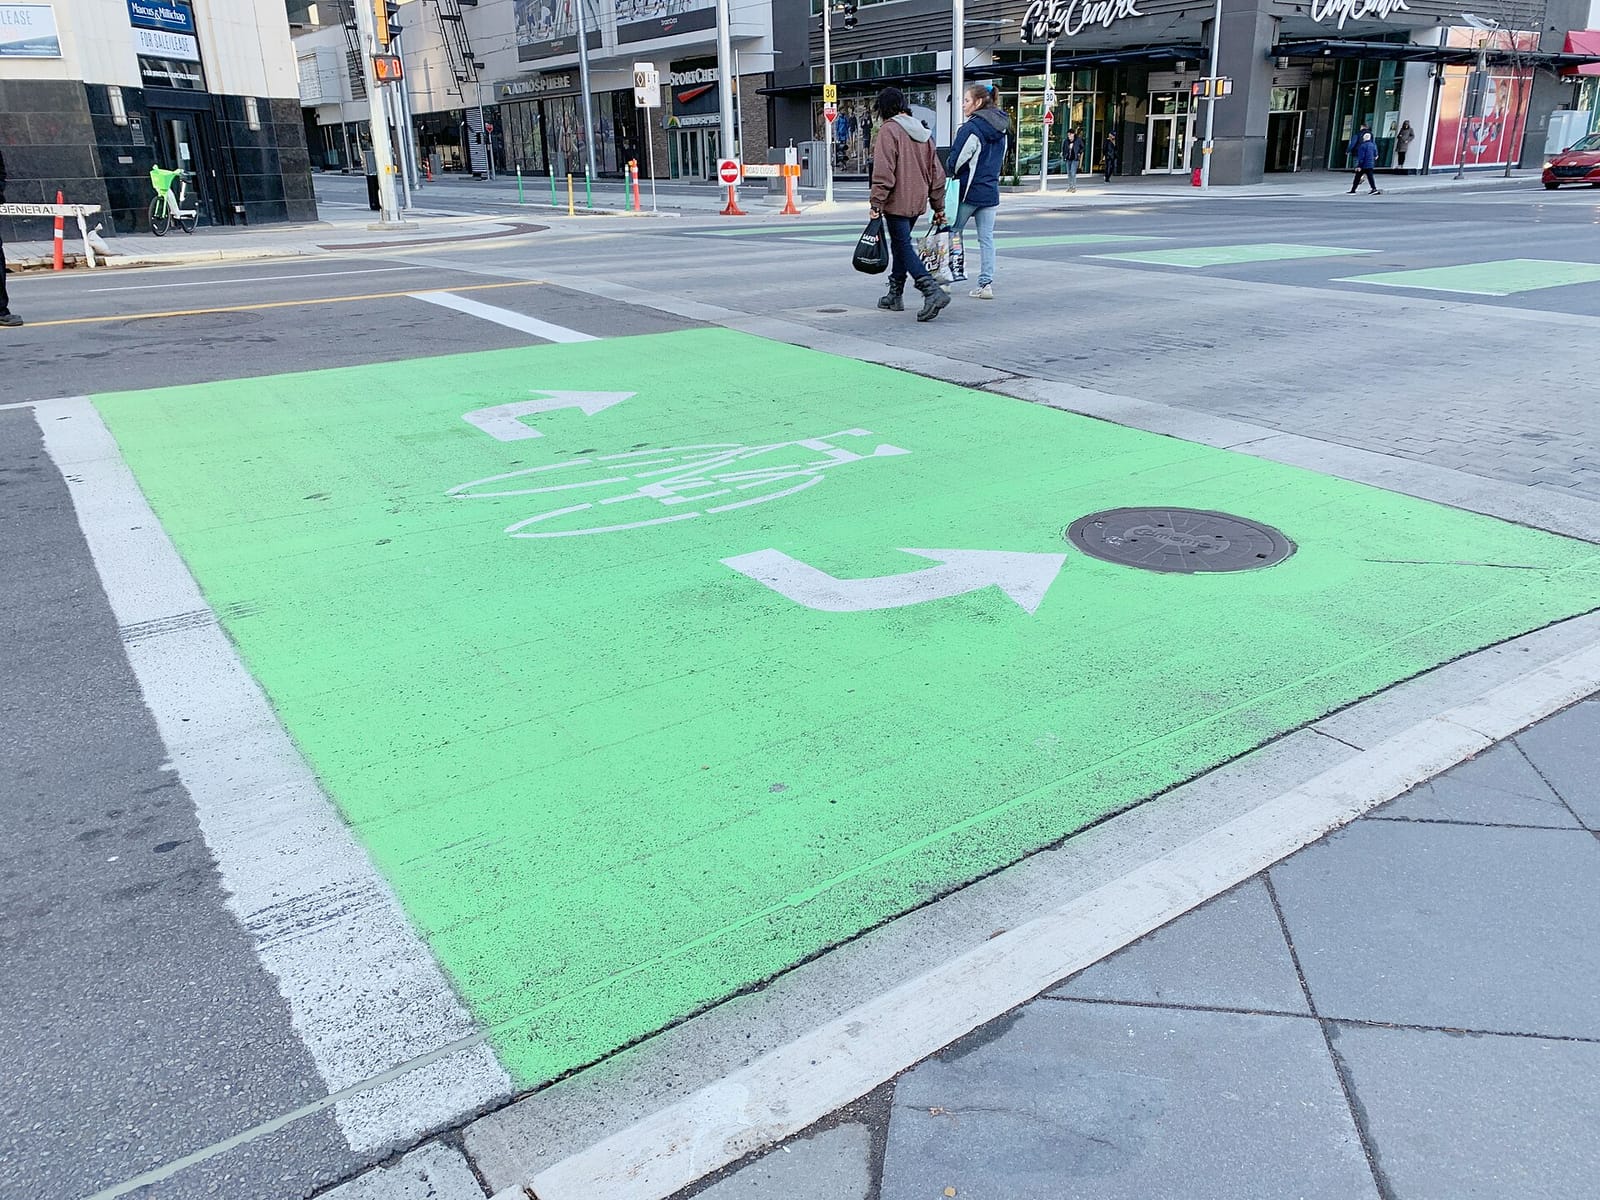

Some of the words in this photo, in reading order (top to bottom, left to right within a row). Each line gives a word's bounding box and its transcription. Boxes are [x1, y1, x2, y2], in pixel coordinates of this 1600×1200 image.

[140, 31, 154, 48] FOR
[825, 88, 835, 98] 30
[1046, 93, 1054, 102] 30
[760, 166, 778, 175] CLOSED
[0, 205, 57, 215] GENERAL
